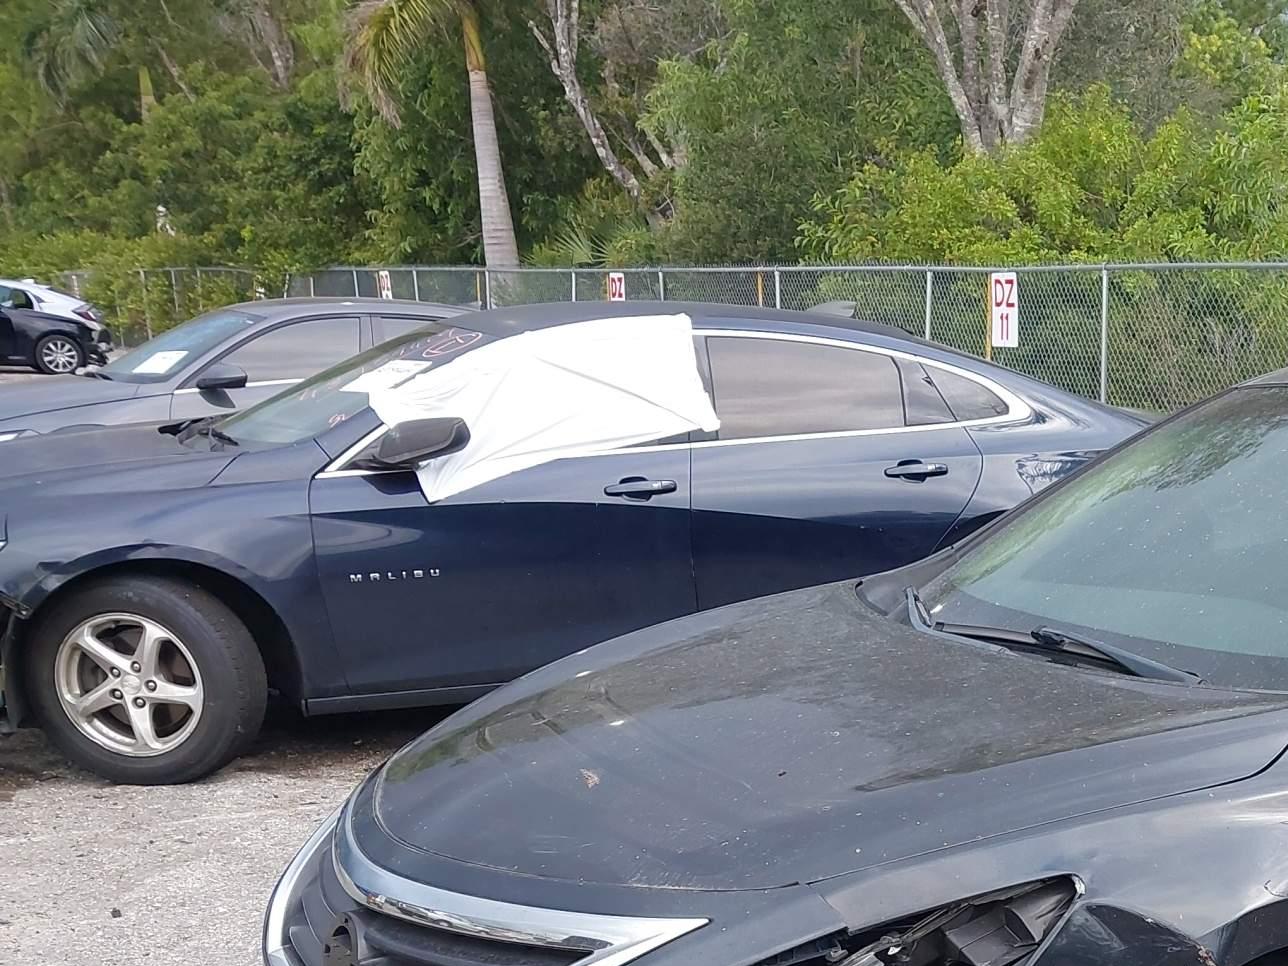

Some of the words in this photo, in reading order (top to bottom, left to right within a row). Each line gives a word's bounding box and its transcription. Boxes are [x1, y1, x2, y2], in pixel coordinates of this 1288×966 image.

[611, 276, 623, 299] DZ
[994, 278, 1015, 308] DZ
[999, 312, 1009, 341] 11
[349, 569, 440, 583] MALIBU
